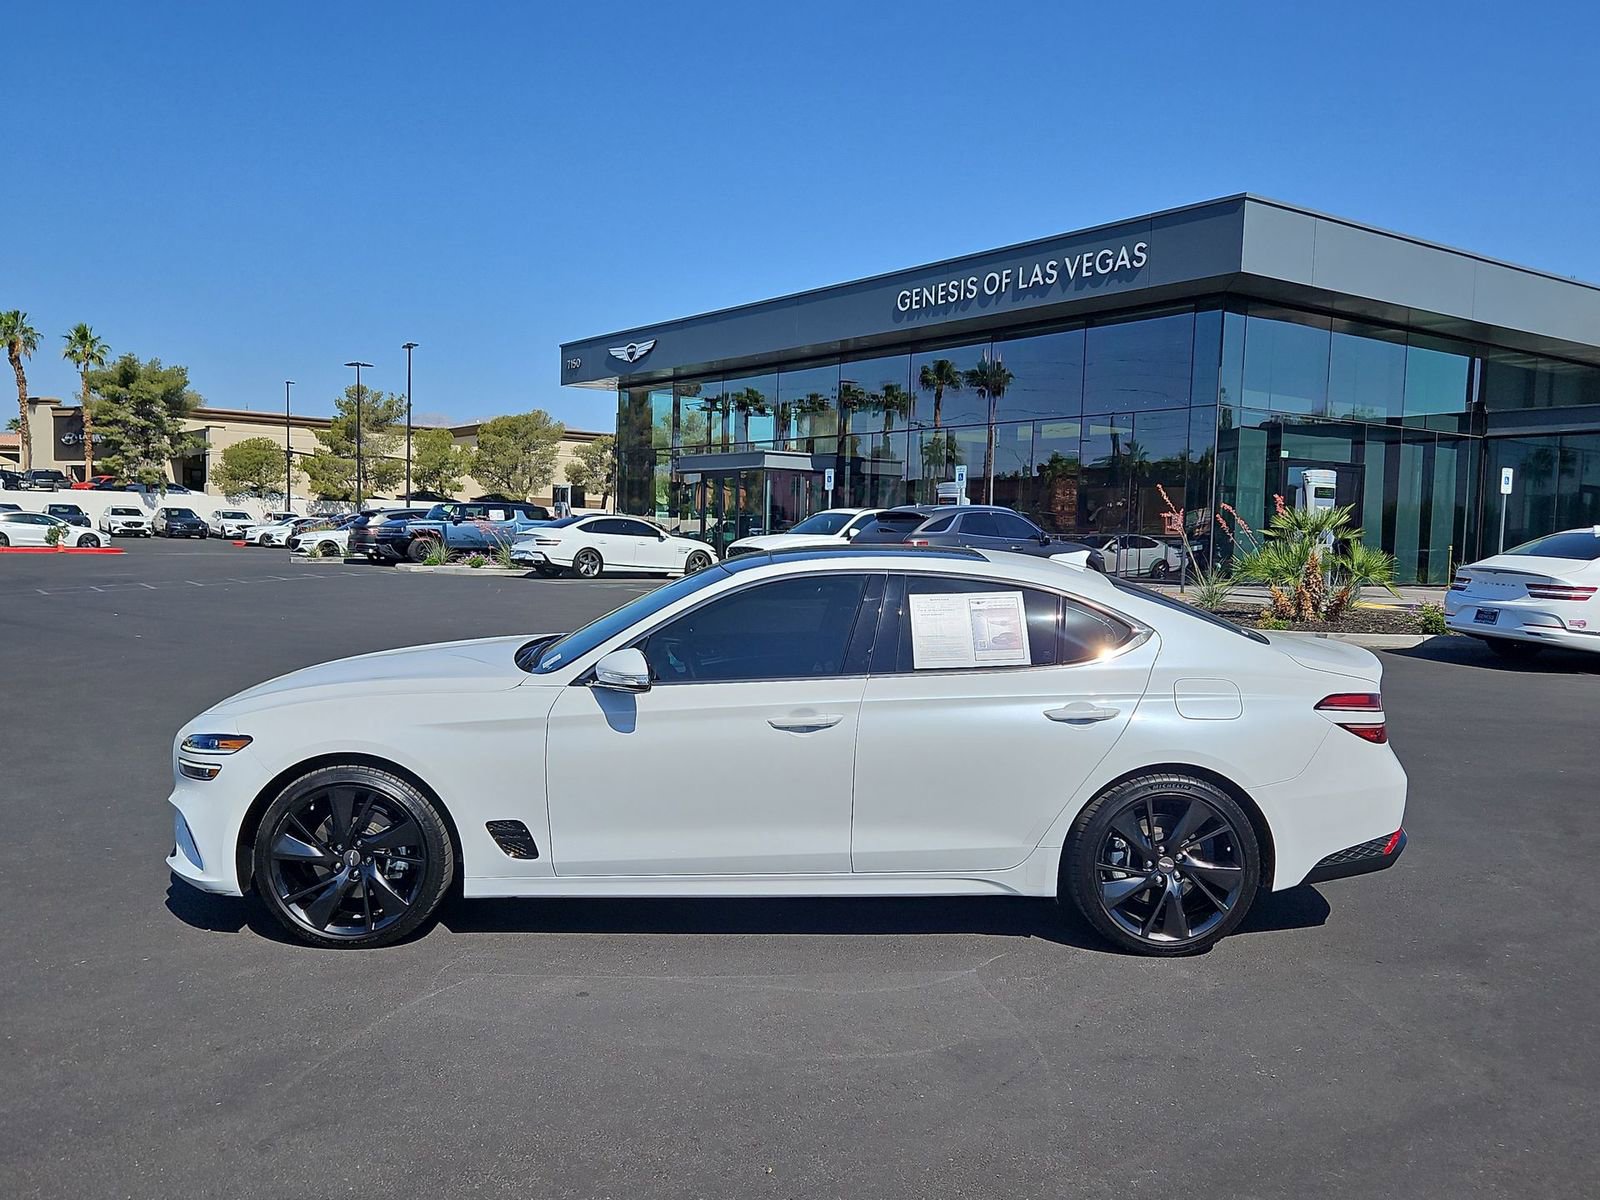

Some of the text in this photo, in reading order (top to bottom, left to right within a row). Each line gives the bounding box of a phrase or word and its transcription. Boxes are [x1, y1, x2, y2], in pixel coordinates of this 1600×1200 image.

[897, 242, 1148, 312] GENESIS OF LAS VEGAS
[567, 358, 581, 370] 7150
